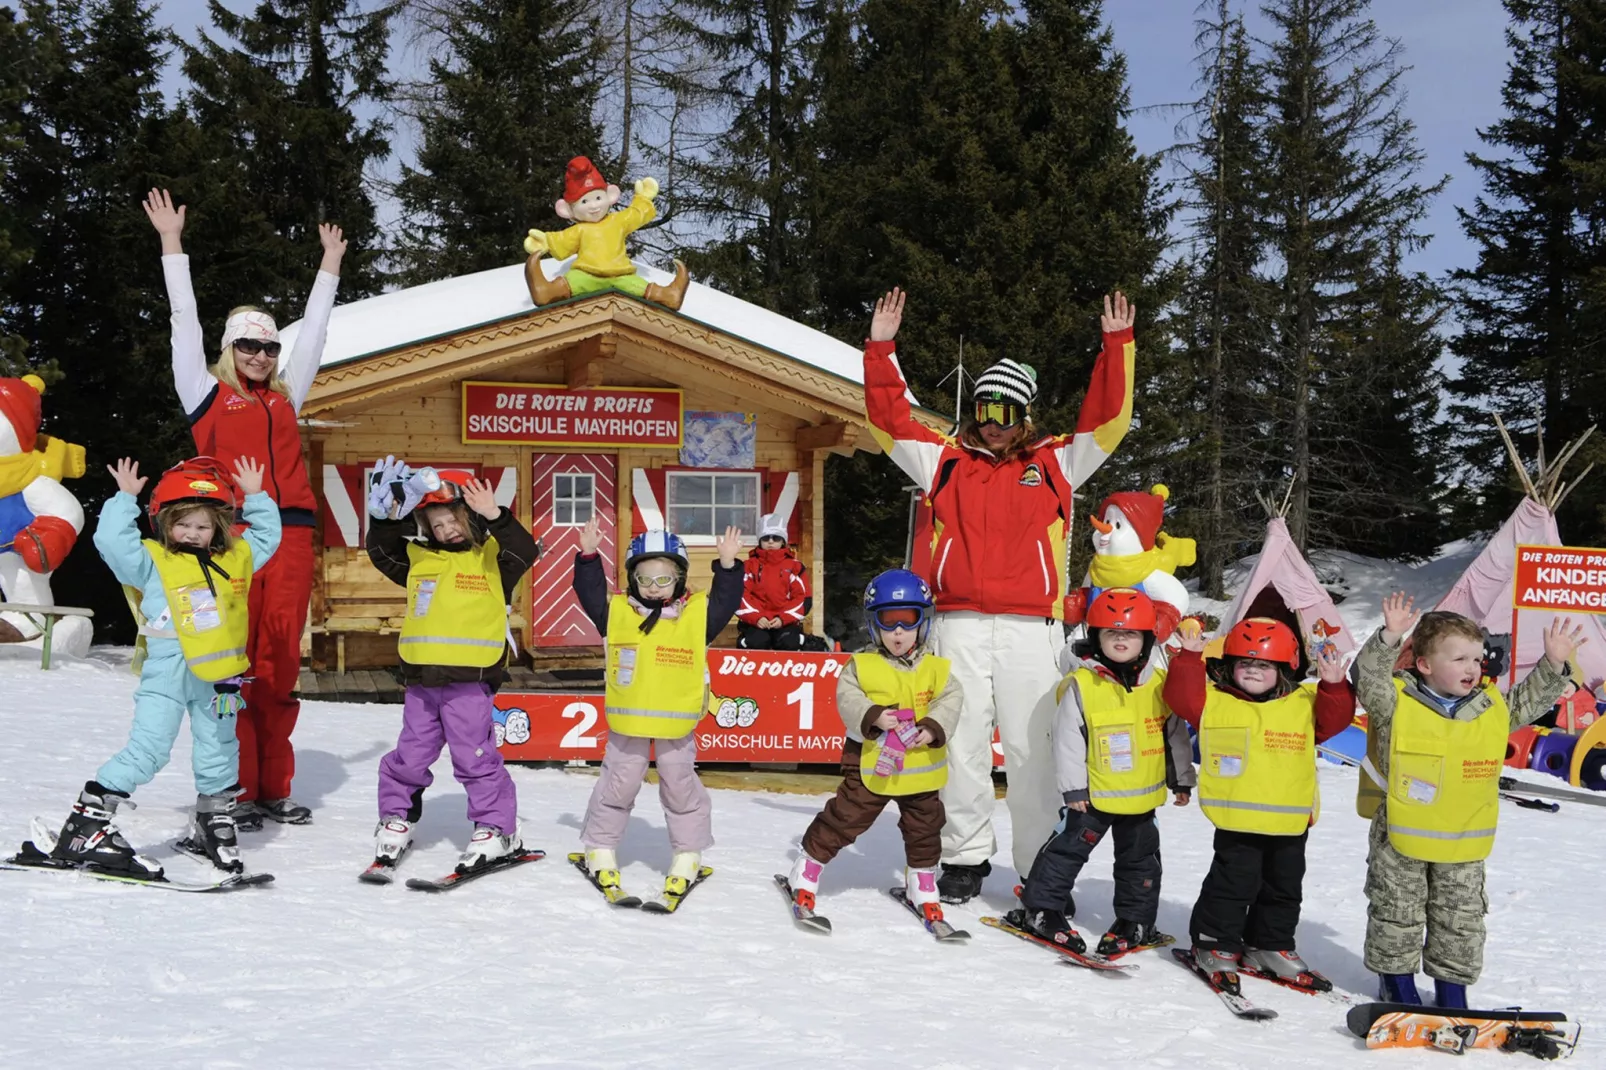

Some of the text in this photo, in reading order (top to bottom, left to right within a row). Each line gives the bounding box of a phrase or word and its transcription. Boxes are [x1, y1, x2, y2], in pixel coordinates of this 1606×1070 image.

[496, 393, 654, 414] DIE ROTEN PROFIS
[468, 413, 568, 435] SKISCHULE
[574, 417, 678, 438] MAYRHOFEN
[1522, 552, 1543, 562] DIE
[1545, 553, 1584, 565] ROTEN
[719, 655, 756, 677] Die
[758, 656, 817, 678] roten
[786, 681, 814, 730] 1
[559, 701, 598, 748] 2
[701, 733, 847, 751] SKISCHULE MAYR
